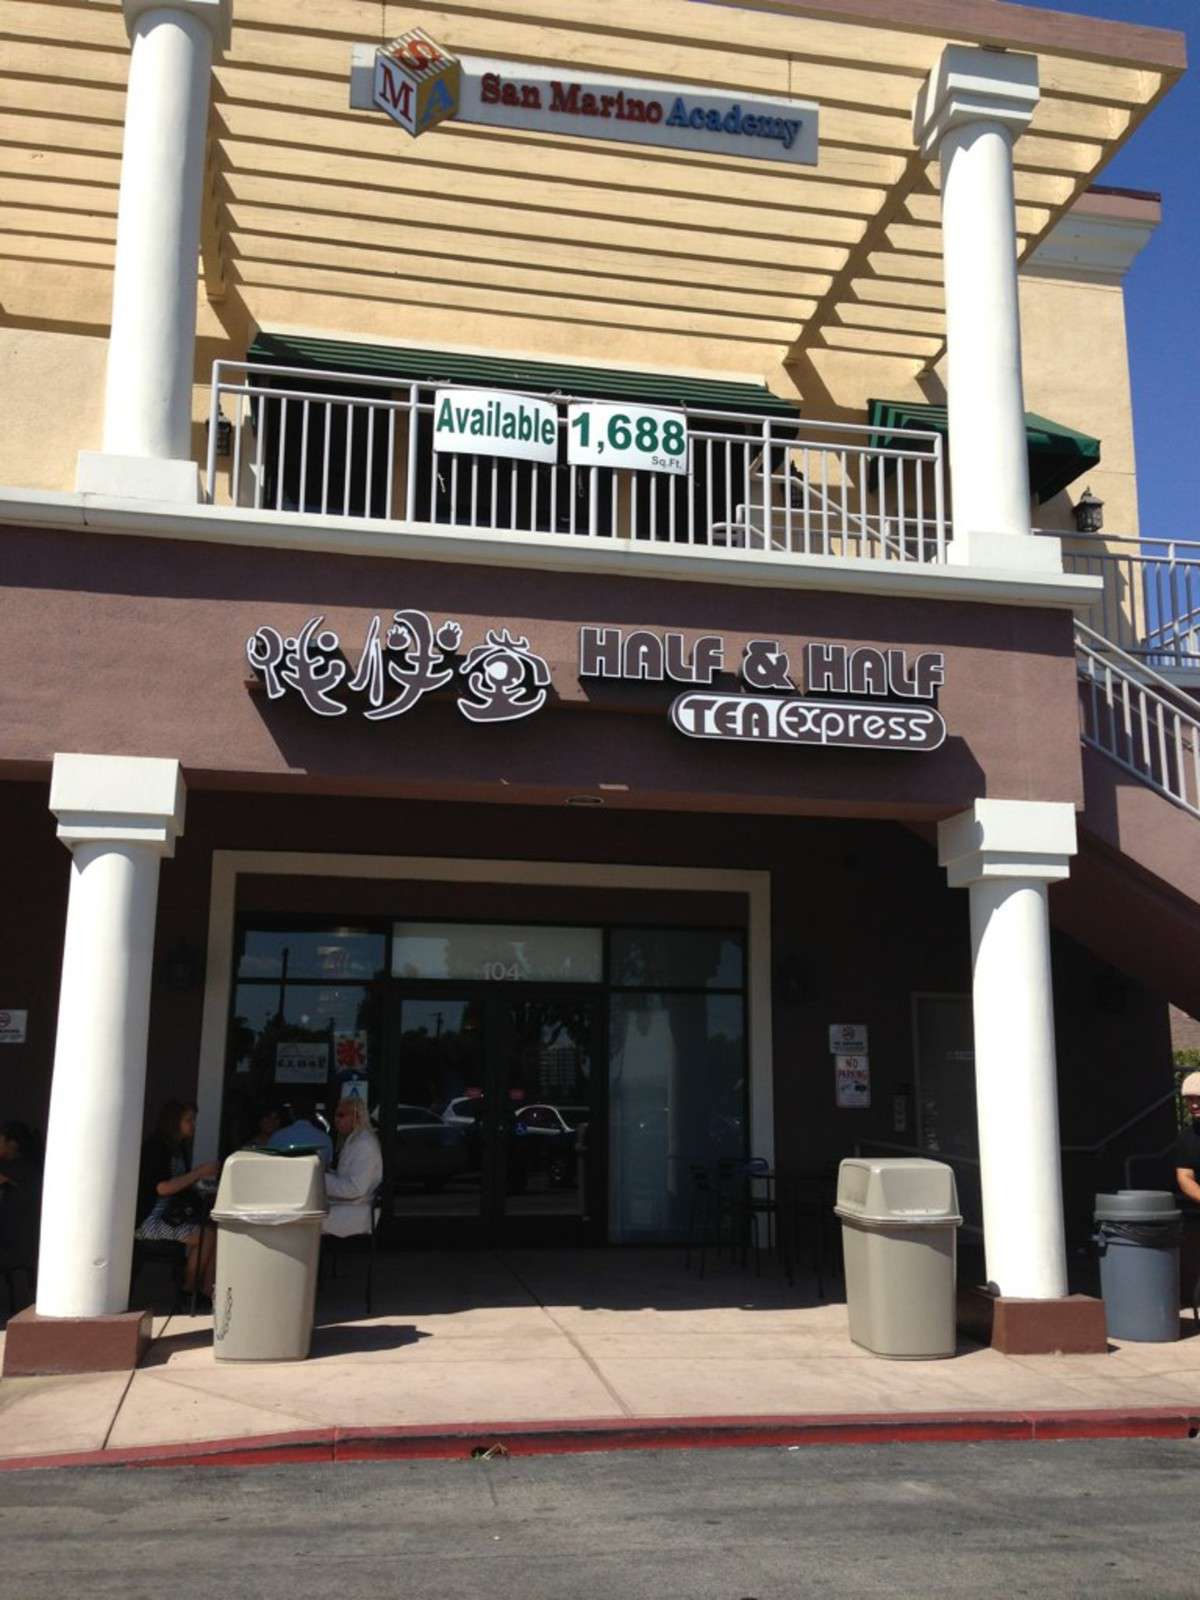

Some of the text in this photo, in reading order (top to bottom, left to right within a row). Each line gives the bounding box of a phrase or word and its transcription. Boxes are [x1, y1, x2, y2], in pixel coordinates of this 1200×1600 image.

[379, 62, 414, 122] M
[423, 78, 455, 123] A
[480, 73, 803, 149] San Marino Academy
[436, 398, 555, 445] Available
[571, 412, 685, 456] 1,688
[580, 626, 944, 699] HALF & HALF
[678, 698, 770, 738] TEA
[482, 961, 522, 981] 104
